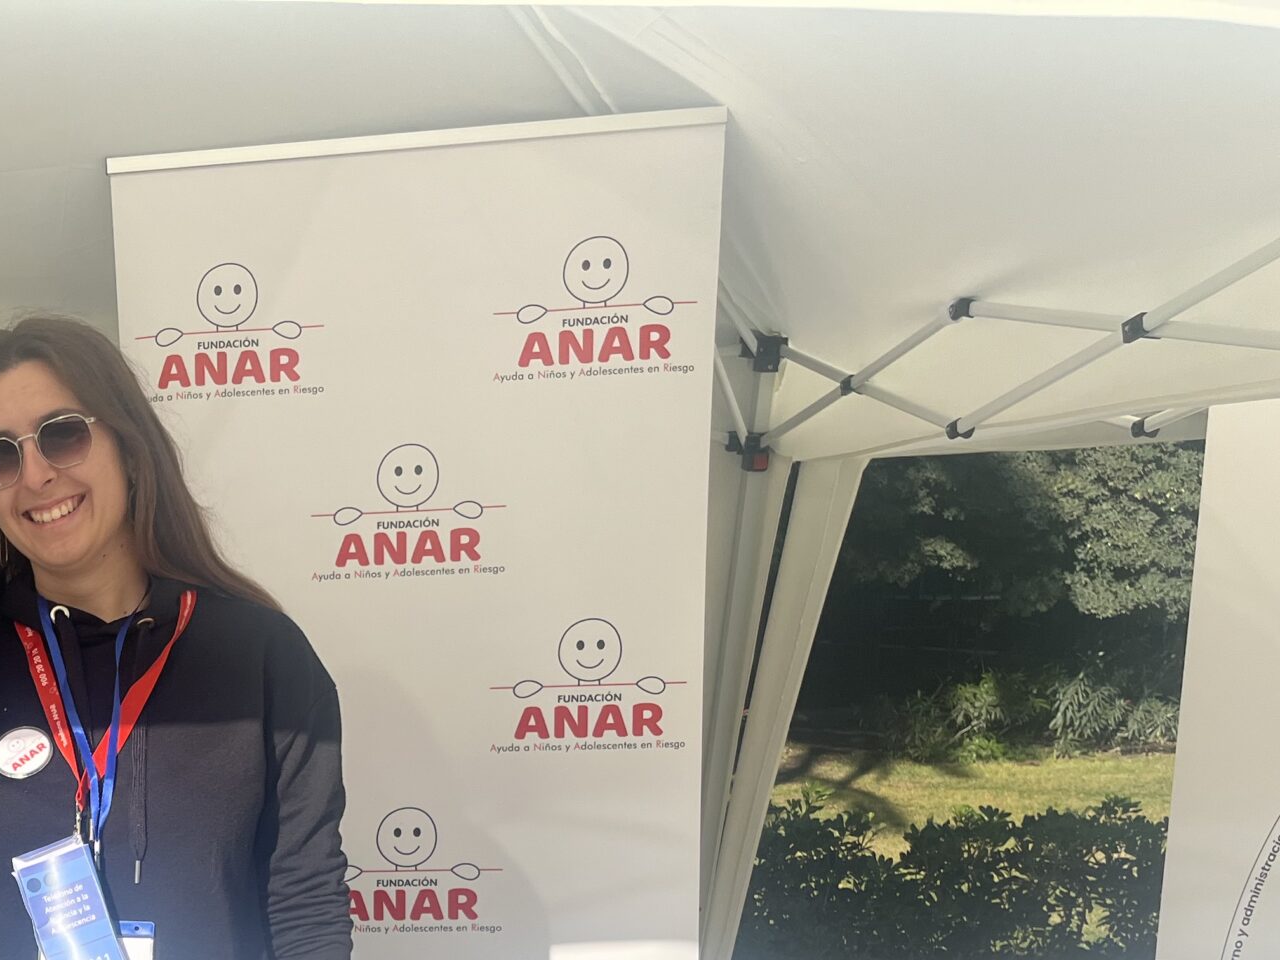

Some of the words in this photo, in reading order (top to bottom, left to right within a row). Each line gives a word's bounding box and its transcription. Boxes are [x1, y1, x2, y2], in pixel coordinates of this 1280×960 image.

[562, 313, 629, 327] FUNDACIÓN
[197, 337, 259, 350] FUNDACIÓN
[518, 324, 671, 368] ANAR
[158, 347, 300, 389] ANAR
[493, 371, 524, 383] Ayuda
[537, 369, 567, 379] Niños
[579, 365, 644, 377] Adolescentes
[647, 365, 660, 373] en
[663, 363, 695, 373] Riesgo
[176, 390, 203, 400] Niños
[214, 387, 276, 398] Adolescentes
[293, 385, 325, 395] Riesgo
[377, 517, 439, 530] FUNDACIÓN
[335, 527, 481, 568] ANAR
[311, 572, 341, 583] Ayuda
[354, 569, 382, 579] Niños
[392, 567, 455, 577] Adolescentes
[458, 567, 470, 575] en
[473, 564, 505, 576] Riesgo
[39, 673, 48, 687] 900
[557, 693, 622, 704] FUNDACIÓN
[514, 703, 664, 740] ANAR
[490, 743, 520, 754] Ayuda
[533, 742, 562, 752] Niños
[573, 741, 637, 751] Adolescentes
[640, 741, 653, 749] en
[655, 739, 686, 750] Riesgo
[12, 743, 47, 771] ANAR
[74, 883, 84, 892] de
[376, 876, 438, 887] FUNDACIÓN
[354, 923, 381, 933] Niños
[392, 922, 453, 933] Adolescentes
[471, 923, 502, 933] Riesgo
[1238, 928, 1249, 938] y
